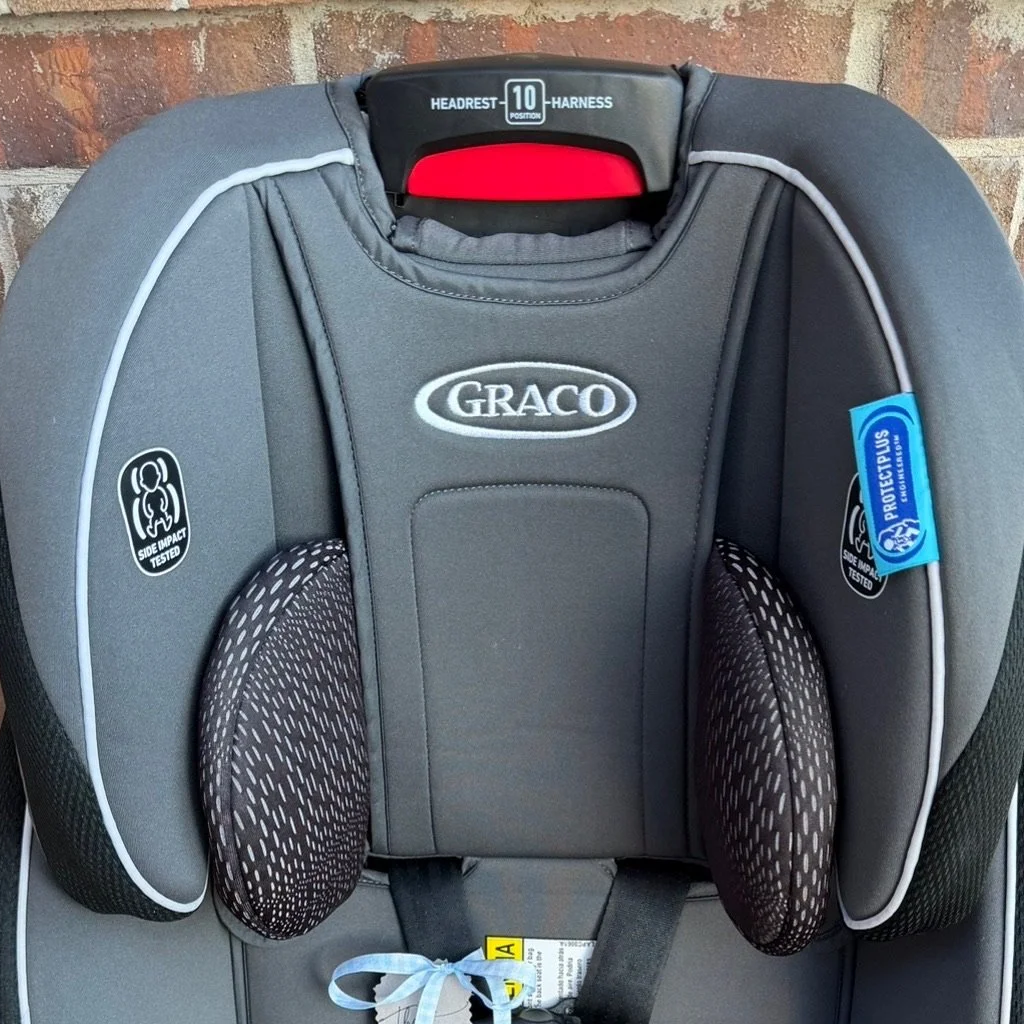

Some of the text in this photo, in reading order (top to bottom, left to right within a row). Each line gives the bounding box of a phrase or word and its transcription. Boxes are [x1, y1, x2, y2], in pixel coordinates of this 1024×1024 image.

[431, 85, 613, 110] HEADREST 10 HARNESS
[510, 112, 541, 120] POSITION
[447, 381, 616, 417] GRACO
[875, 429, 899, 521] PROTECTPLUS
[138, 527, 186, 560] SIDE IMPACT
[150, 545, 180, 568] TESTED
[842, 549, 858, 567] SIDE
[848, 566, 873, 591] TESTED
[527, 948, 535, 960] bag
